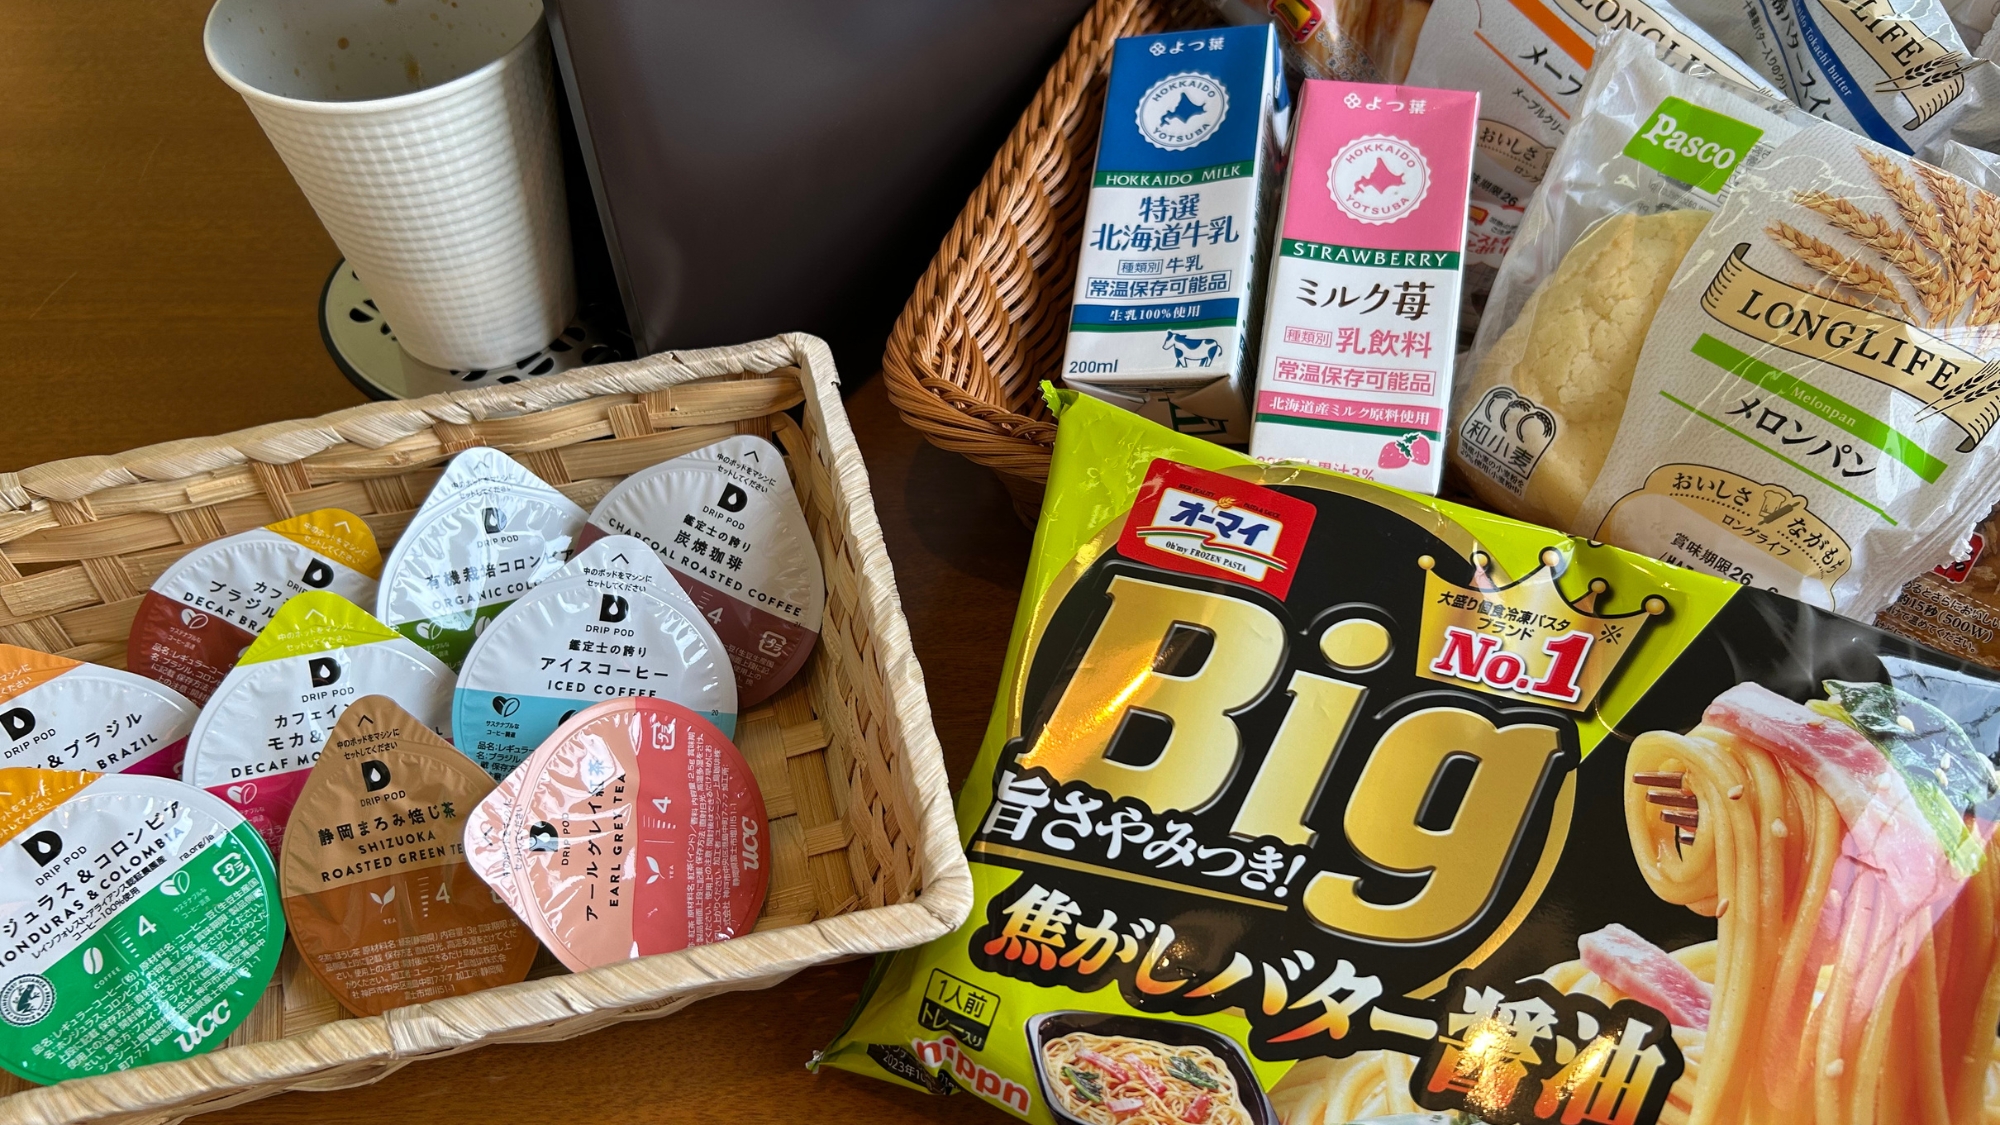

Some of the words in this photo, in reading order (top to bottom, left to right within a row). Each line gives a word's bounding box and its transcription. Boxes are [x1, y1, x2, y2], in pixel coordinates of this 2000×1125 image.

[1169, 36, 1226, 55] よつ葉
[1805, 27, 1830, 66] Tokachi
[1827, 67, 1853, 97] butter
[1151, 80, 1217, 104] HOKKAIDO
[1365, 97, 1427, 115] よつ葉
[1152, 122, 1213, 144] YOTSUBA
[1479, 128, 1538, 161] おいしさ
[1641, 113, 1735, 169] Pasco
[1345, 143, 1416, 169] HOKKAIDO
[1106, 172, 1193, 187] HOKKAIDO
[1201, 164, 1241, 182] MILK
[1140, 194, 1200, 223] 特選
[1345, 194, 1409, 216] YOTSUBA
[1090, 216, 1239, 252] 北海道牛乳
[1120, 262, 1161, 274] 種類別
[1166, 255, 1204, 273] 牛乳
[1293, 242, 1448, 268] STRAWBERRY
[1090, 273, 1228, 299] 常温保存可能品
[1296, 280, 1435, 321] ミルク苺
[1109, 305, 1201, 323] 生乳100%使用
[1286, 329, 1330, 347] 種類別
[1336, 328, 1432, 359] 乳飲料
[1738, 288, 1961, 391] LONGLIFE
[1069, 358, 1118, 374] 200ml
[1276, 360, 1434, 393] 常温保存可能品
[1270, 396, 1430, 426] 北海道産ミルク原料使用
[1790, 387, 1857, 430] Melonpan
[1467, 420, 1534, 474] 和小麦
[1725, 397, 1877, 480] メロンパン
[716, 453, 776, 487] 中のポッドをマシンに
[717, 465, 768, 494] セットしてください
[1672, 472, 1752, 506] おいしさ
[702, 505, 724, 519] DRIP
[726, 517, 745, 531] POD
[1169, 500, 1270, 546] オーマイ
[477, 537, 499, 549] DRIP
[501, 534, 519, 544] POD
[683, 514, 751, 553] 鑑定士の誇り
[1722, 514, 1791, 556] ロングライフ
[1788, 518, 1844, 573] ながもち
[674, 530, 743, 572] 炭焼珈琲
[1166, 541, 1188, 555] Oh'my
[1190, 544, 1222, 562] FROZEN
[1223, 558, 1246, 572] PASTA
[583, 567, 652, 583] 中のポッドをマシンに
[608, 517, 677, 560] CHARCOAL
[681, 556, 743, 591] ROASTED
[748, 588, 802, 617] COFFEE
[210, 580, 274, 619] ブラジル
[432, 587, 502, 610] ORGANIC
[587, 578, 646, 593] セットしてください
[183, 591, 235, 619] DECAF
[707, 607, 724, 625] 4
[1437, 591, 1571, 632] 大盛り個食冷凍パスタ
[586, 624, 610, 634] DRIP
[614, 627, 635, 637] POD
[1477, 617, 1535, 640] ブランド
[569, 638, 647, 657] 鑑定士の誇り
[540, 657, 669, 679] アイスコーヒー
[1432, 628, 1590, 700] No.1
[301, 691, 328, 703] DRIP
[332, 686, 355, 698] POD
[548, 680, 586, 692] ICED
[594, 684, 657, 697] COFFEE
[336, 728, 400, 750] 中のポッドをマシンに
[486, 720, 520, 730] サステナブルな
[3, 741, 31, 759] DRIP
[33, 728, 56, 745] POD
[96, 733, 158, 770] BRAZIL
[344, 741, 398, 760] セットしてください
[1015, 574, 1565, 943] Big
[231, 760, 289, 778] DECAF
[360, 794, 383, 807] DRIP
[384, 790, 406, 802] POD
[613, 774, 626, 804] TEA
[652, 796, 671, 814] 4
[318, 801, 457, 847] 静岡まろみ焙じ茶
[561, 812, 570, 836] POD
[612, 811, 624, 856] GREY
[982, 769, 1307, 899] 旨さやみつき!
[178, 833, 215, 862] ra.org/ja
[358, 830, 436, 854] SHIZUOKA
[561, 842, 570, 866] DRIP
[586, 758, 606, 921] アールグレイ紅茶
[35, 863, 62, 887] DRIP
[63, 845, 87, 866] POD
[87, 888, 100, 902] &
[101, 826, 184, 892] COLOMBIA
[321, 856, 393, 883] ROASTED
[398, 845, 446, 865] GREEN
[436, 882, 451, 904] 4
[609, 863, 621, 907] EARL
[72, 886, 141, 942] コーヒー100%使用
[138, 915, 157, 937] 4
[382, 917, 397, 925] TEA
[94, 966, 122, 990] COFFEE
[31, 969, 140, 1056] 品名：レギュラーコーヒー（粉）
[937, 980, 987, 1018] 1人前
[984, 882, 1666, 1125] 焦がしバター醤油
[921, 1002, 983, 1047] トレー入り
[914, 1037, 1031, 1114] nippn
